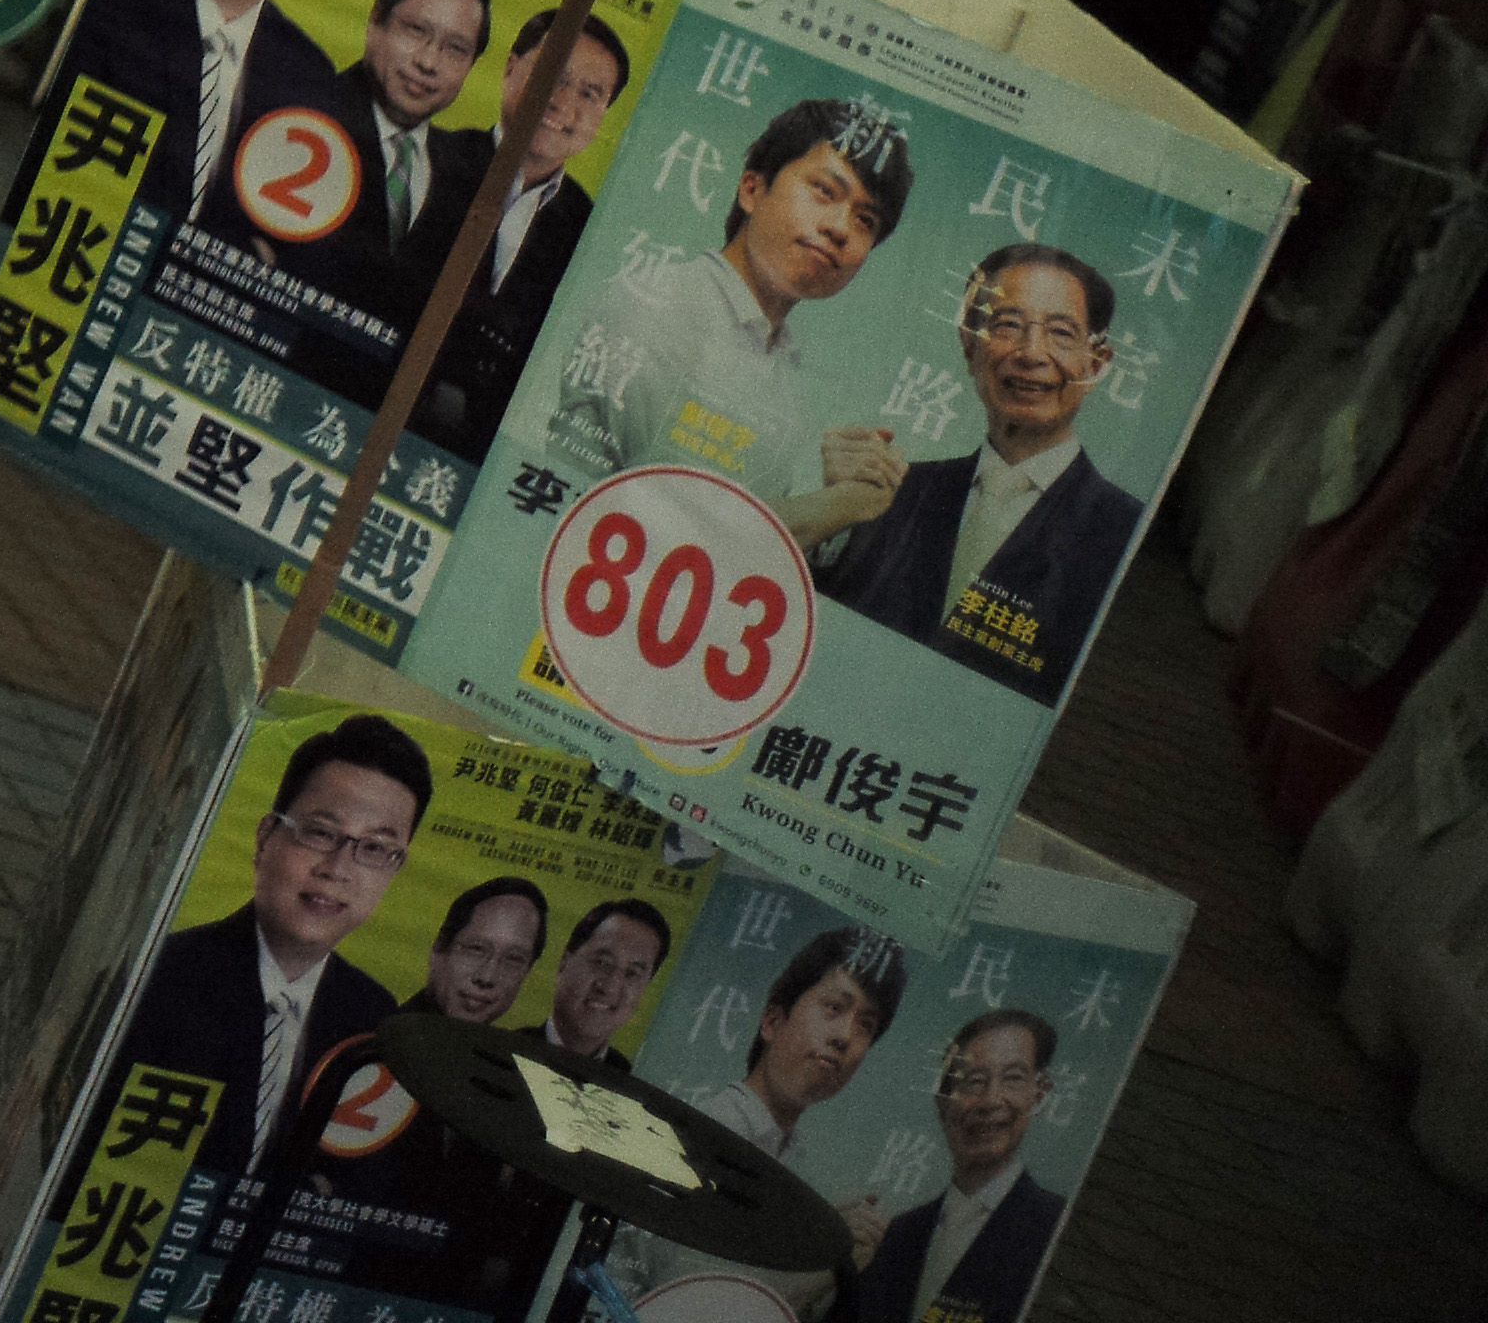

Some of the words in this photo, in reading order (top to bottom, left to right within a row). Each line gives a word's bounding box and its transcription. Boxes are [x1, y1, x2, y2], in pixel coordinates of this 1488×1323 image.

[258, 127, 330, 218] 2
[76, 205, 154, 359] ANDREW
[47, 359, 104, 438] WAN
[130, 315, 285, 424] 反特權
[89, 369, 436, 605] 並堅作戰
[505, 460, 568, 519] 李
[564, 509, 789, 705] 803
[956, 590, 1041, 646] 李柱銘
[1012, 589, 1034, 613] Lee
[943, 614, 1046, 676] 民主黨創黨主席
[514, 687, 559, 721] Please
[561, 711, 591, 732] vote
[593, 722, 616, 745] for
[453, 756, 522, 794] 尹兆堅
[528, 772, 594, 810] 何俊仁
[750, 723, 980, 847] 鄺俊宇
[741, 791, 818, 845] Kwong
[826, 831, 889, 871] Chun
[893, 860, 925, 891] Yu
[137, 1173, 217, 1313] ANDREW
[234, 1176, 450, 1238] 英國克大學社會學文學碩士
